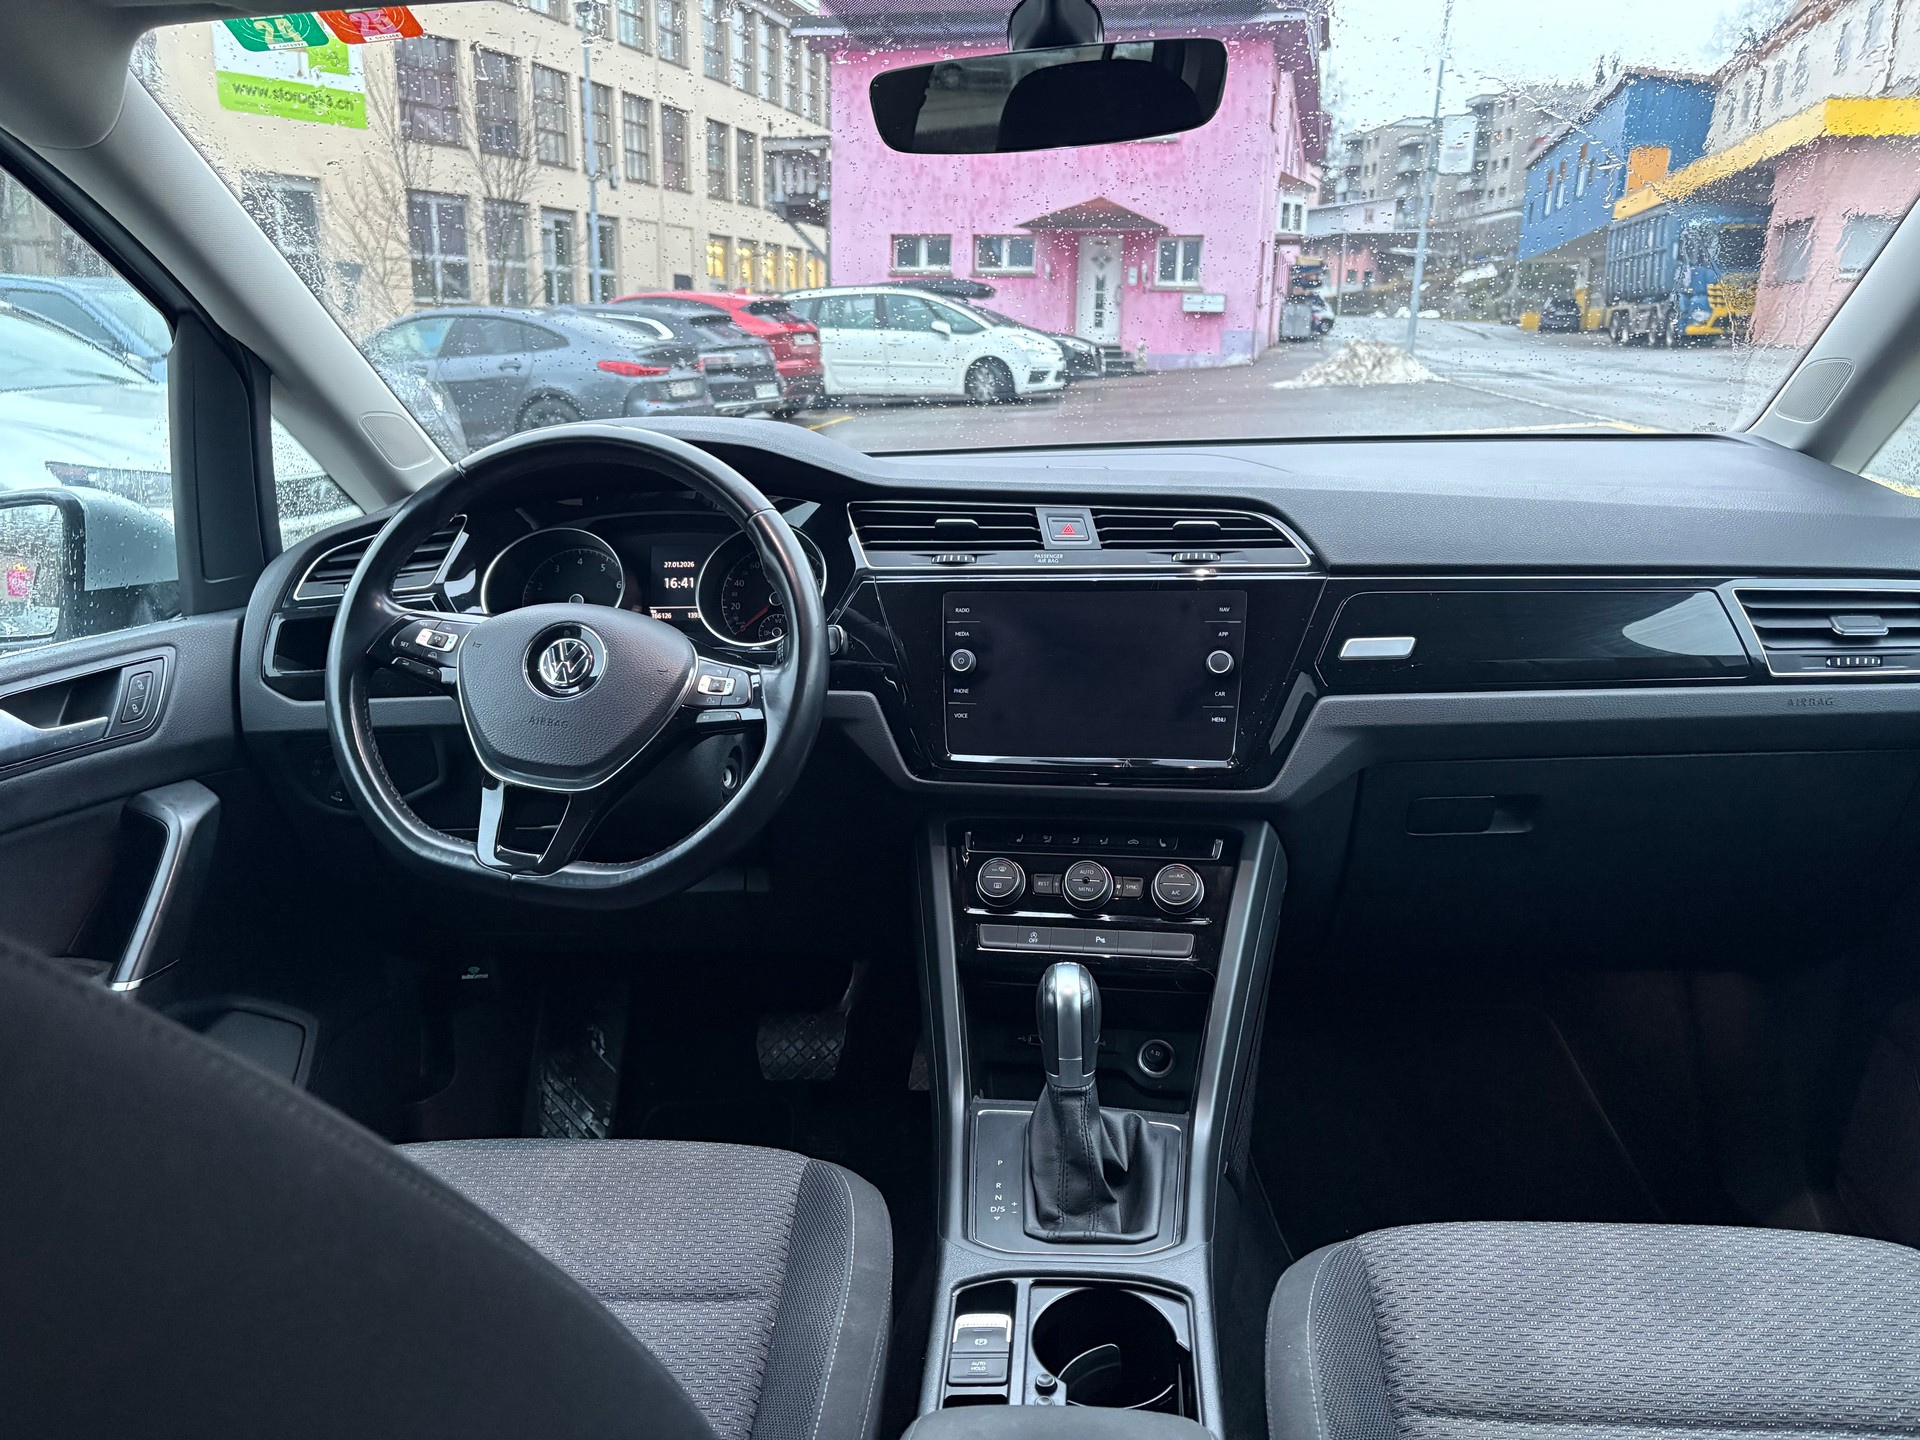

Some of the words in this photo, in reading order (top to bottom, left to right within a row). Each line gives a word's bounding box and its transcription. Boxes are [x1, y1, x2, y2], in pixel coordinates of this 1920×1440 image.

[600, 563, 606, 572] 5
[664, 577, 694, 589] 16:41
[734, 579, 745, 587] 40
[1788, 697, 1834, 707] AIRBAG
[528, 716, 569, 729] AIRBAG
[990, 1205, 1006, 1213] D/S
